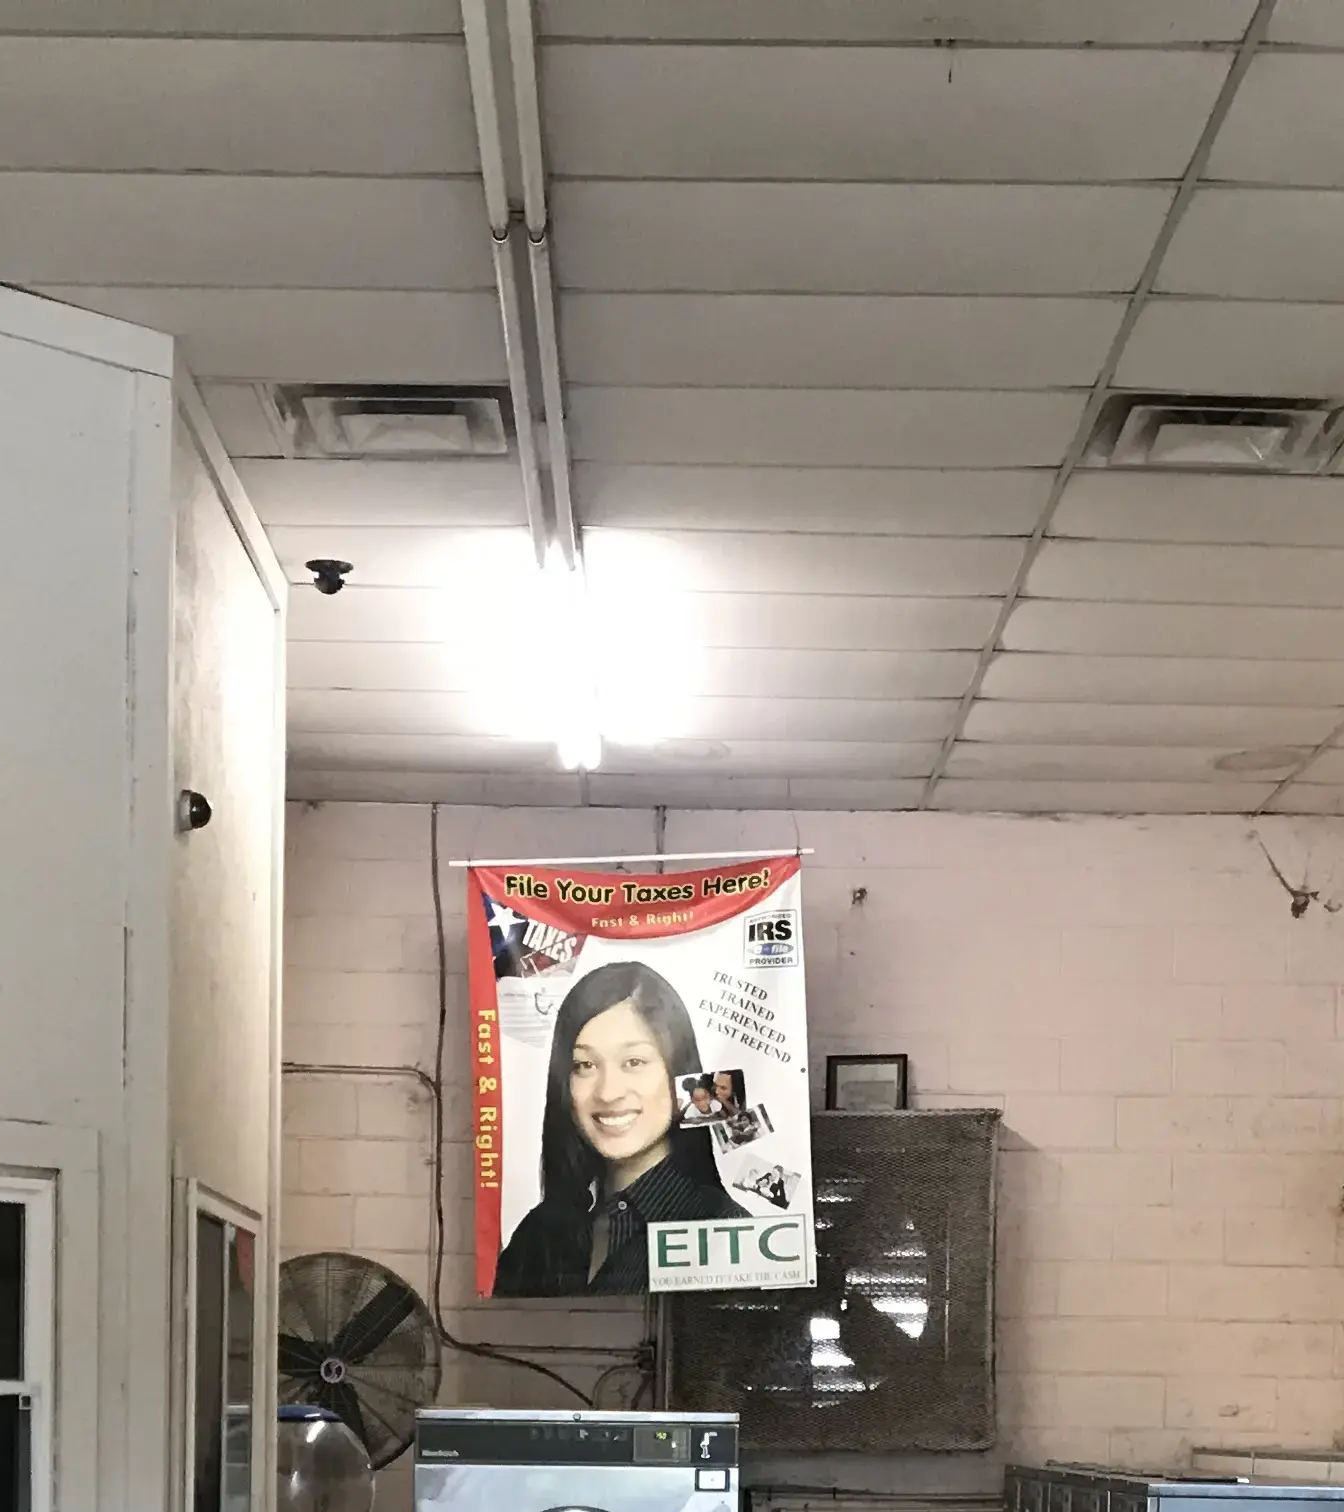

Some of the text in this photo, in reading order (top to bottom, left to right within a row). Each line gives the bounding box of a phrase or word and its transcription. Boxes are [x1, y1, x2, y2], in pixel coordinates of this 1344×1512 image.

[505, 869, 770, 903] File Your Taxes Here!
[591, 910, 694, 929] Fast & Right!
[748, 920, 792, 942] IRS
[522, 917, 577, 962] TAXES
[749, 957, 793, 966] PROVIDER
[712, 970, 768, 1001] TRUSTED
[699, 999, 786, 1045] EXPERIENCED
[720, 989, 775, 1022] TRAINED
[706, 1018, 792, 1064] FAST REFUND
[476, 1009, 499, 1188] Fast & Right!
[657, 1222, 801, 1268] EITC
